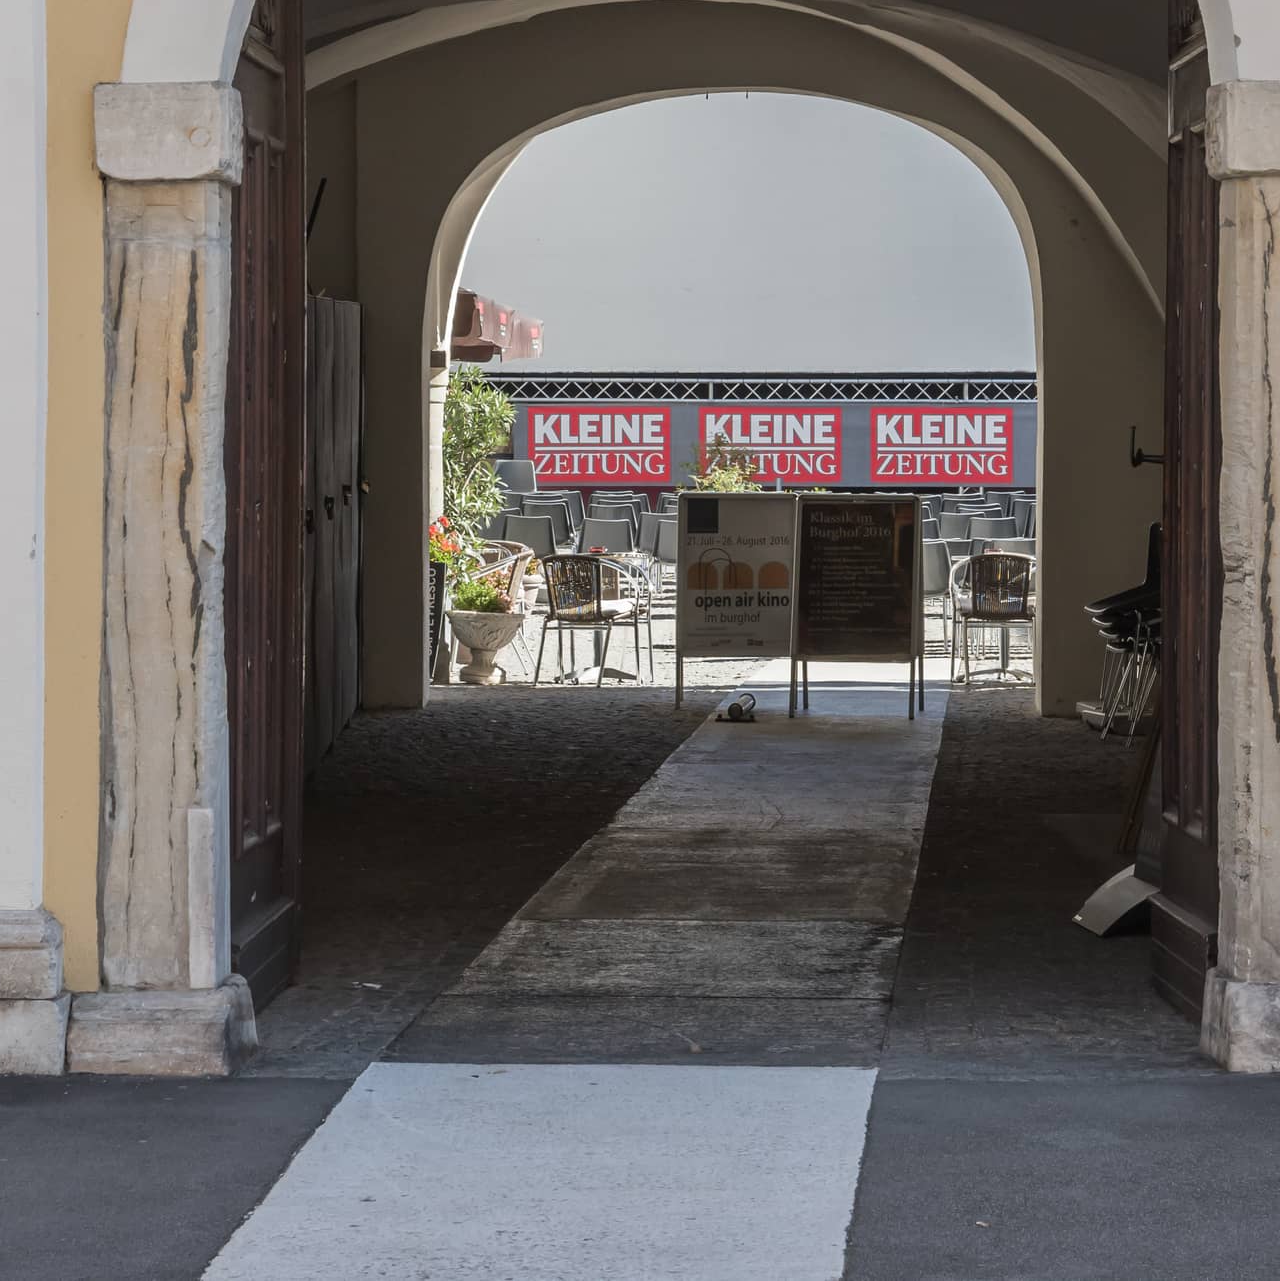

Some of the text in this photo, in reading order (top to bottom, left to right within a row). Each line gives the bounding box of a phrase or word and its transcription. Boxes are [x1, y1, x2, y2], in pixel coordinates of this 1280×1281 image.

[534, 414, 664, 444] KLEINE
[706, 414, 836, 444] KLEINE
[877, 414, 1007, 444] KLEINE
[534, 452, 665, 475] ZEITUNG
[876, 452, 1008, 476] ZEITUNG
[810, 510, 853, 524] Klassik
[736, 535, 766, 548] August
[810, 526, 892, 541] Burghof 2016
[695, 592, 790, 611] open air kino
[704, 612, 761, 626] im burghof
